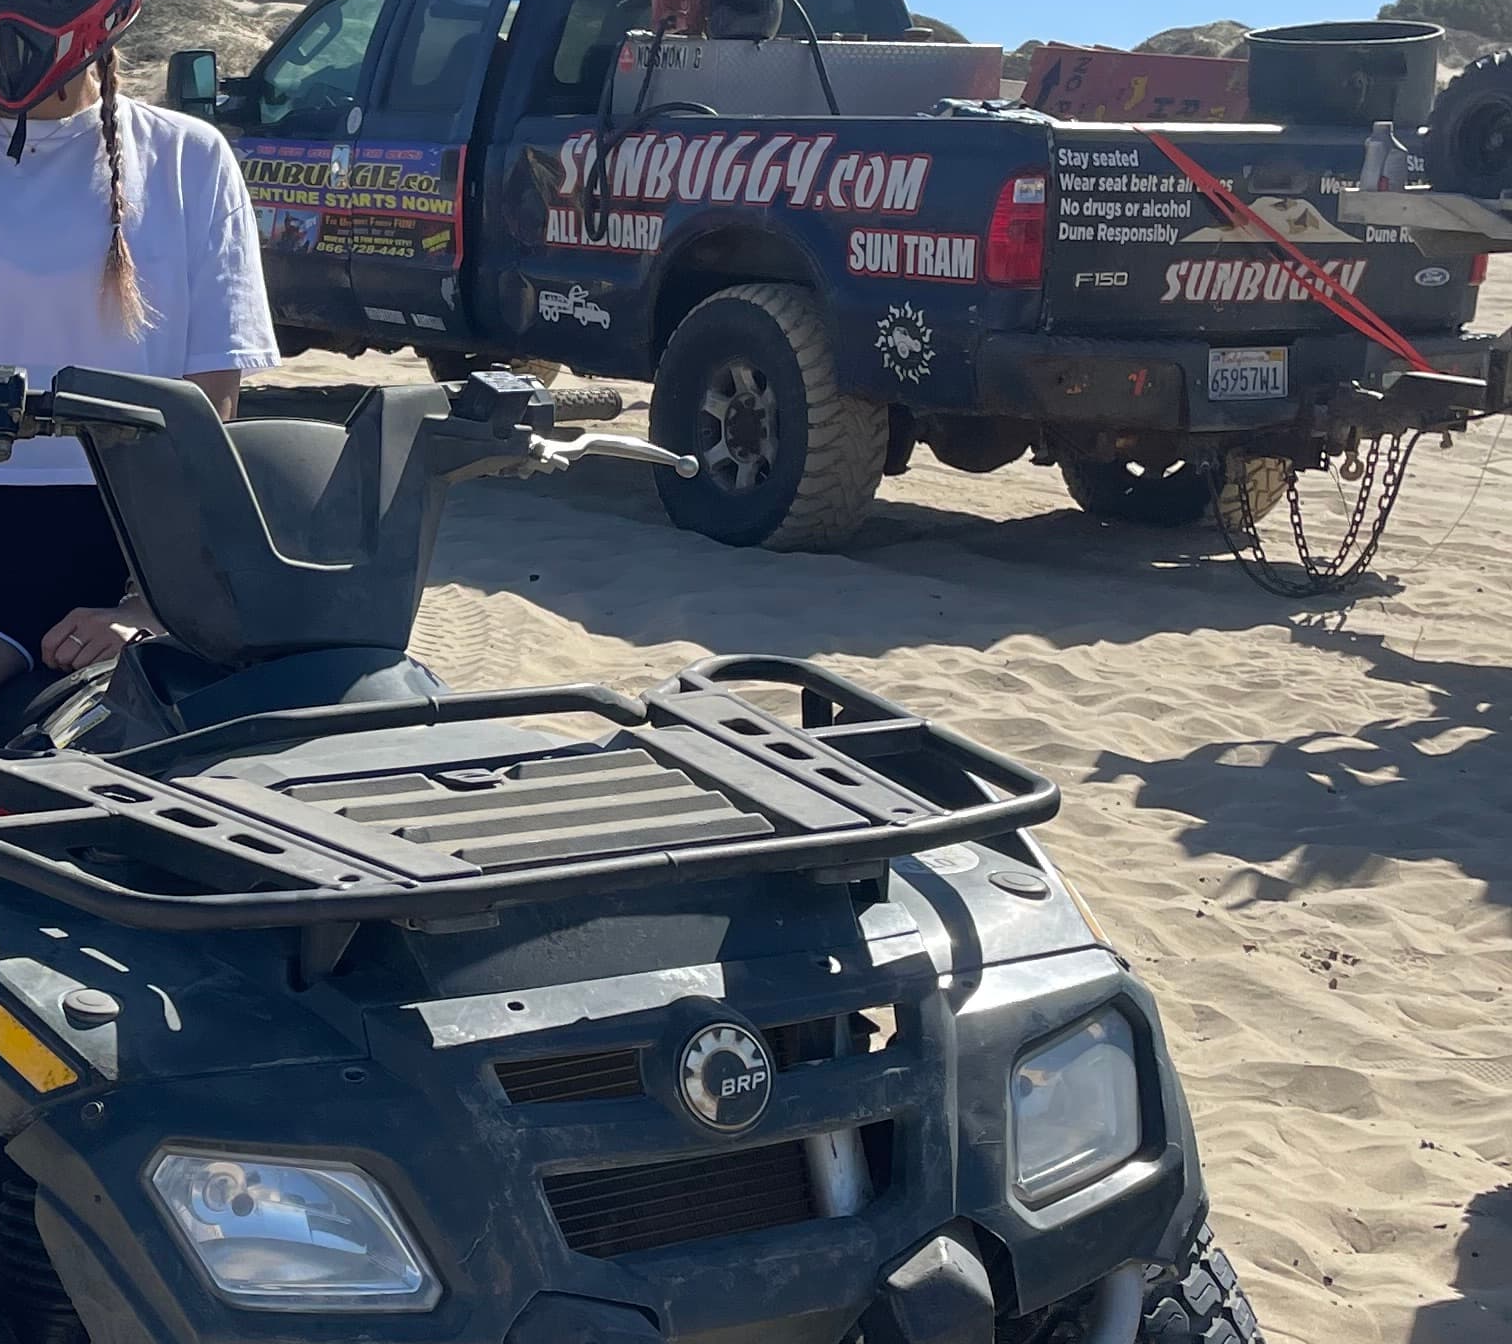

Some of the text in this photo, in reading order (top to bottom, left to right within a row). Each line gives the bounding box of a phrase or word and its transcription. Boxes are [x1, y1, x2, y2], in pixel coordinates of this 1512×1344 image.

[655, 46, 701, 69] SMOKIG
[1058, 148, 1139, 169] Stay seated
[1059, 173, 1096, 192] Wear
[1098, 174, 1128, 192] seat
[1130, 174, 1158, 193] belt
[1160, 176, 1175, 192] at
[324, 190, 396, 209] STARTS
[401, 196, 453, 215] NOW!
[1060, 197, 1191, 220] No drugs or alcohol
[545, 209, 578, 244] ALL
[1058, 222, 1179, 245] Dune Responsibly
[1366, 225, 1397, 243] Dune
[849, 231, 976, 279] SUN TRAM
[1211, 367, 1281, 393] 65957W1
[721, 1071, 766, 1097] BRP
